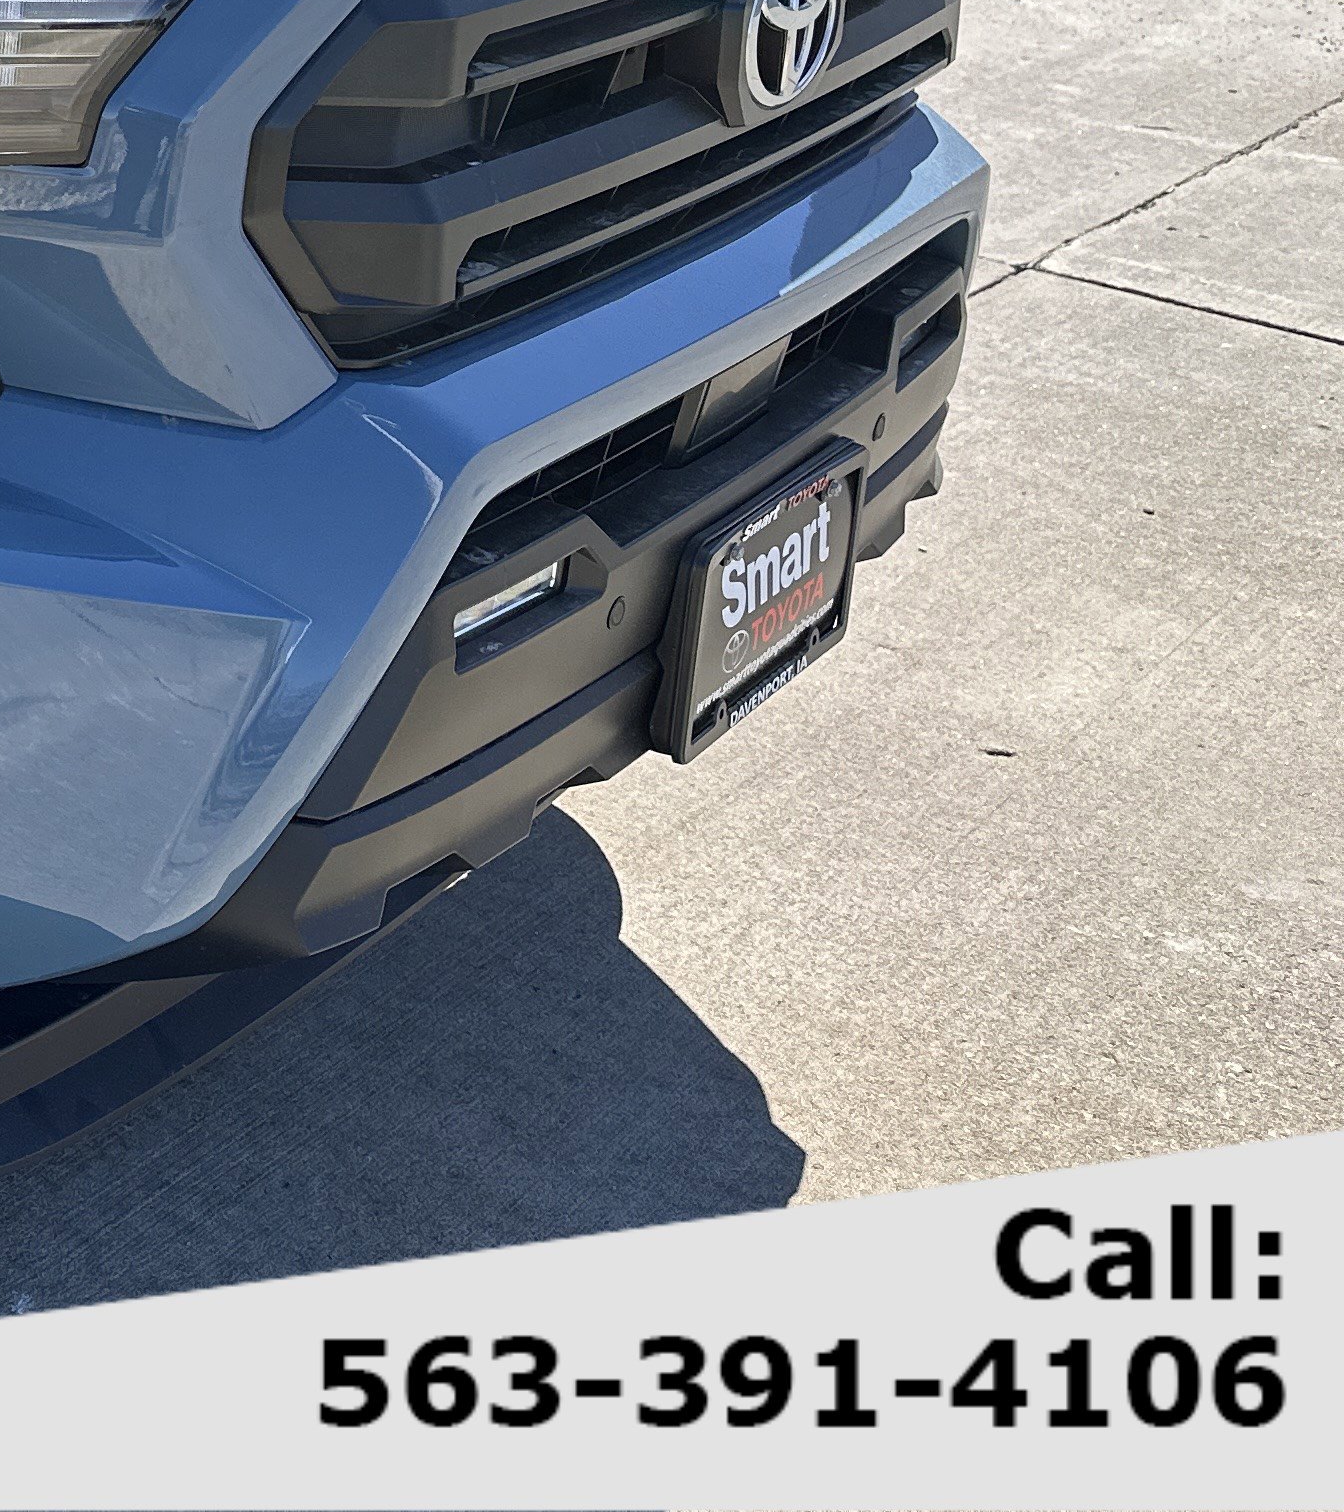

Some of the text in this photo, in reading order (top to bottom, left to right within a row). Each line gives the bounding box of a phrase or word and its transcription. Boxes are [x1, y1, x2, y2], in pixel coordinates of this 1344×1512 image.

[741, 502, 780, 542] Smart
[722, 501, 831, 628] Smart
[751, 572, 824, 651] TOYOTA
[796, 654, 808, 676] IA
